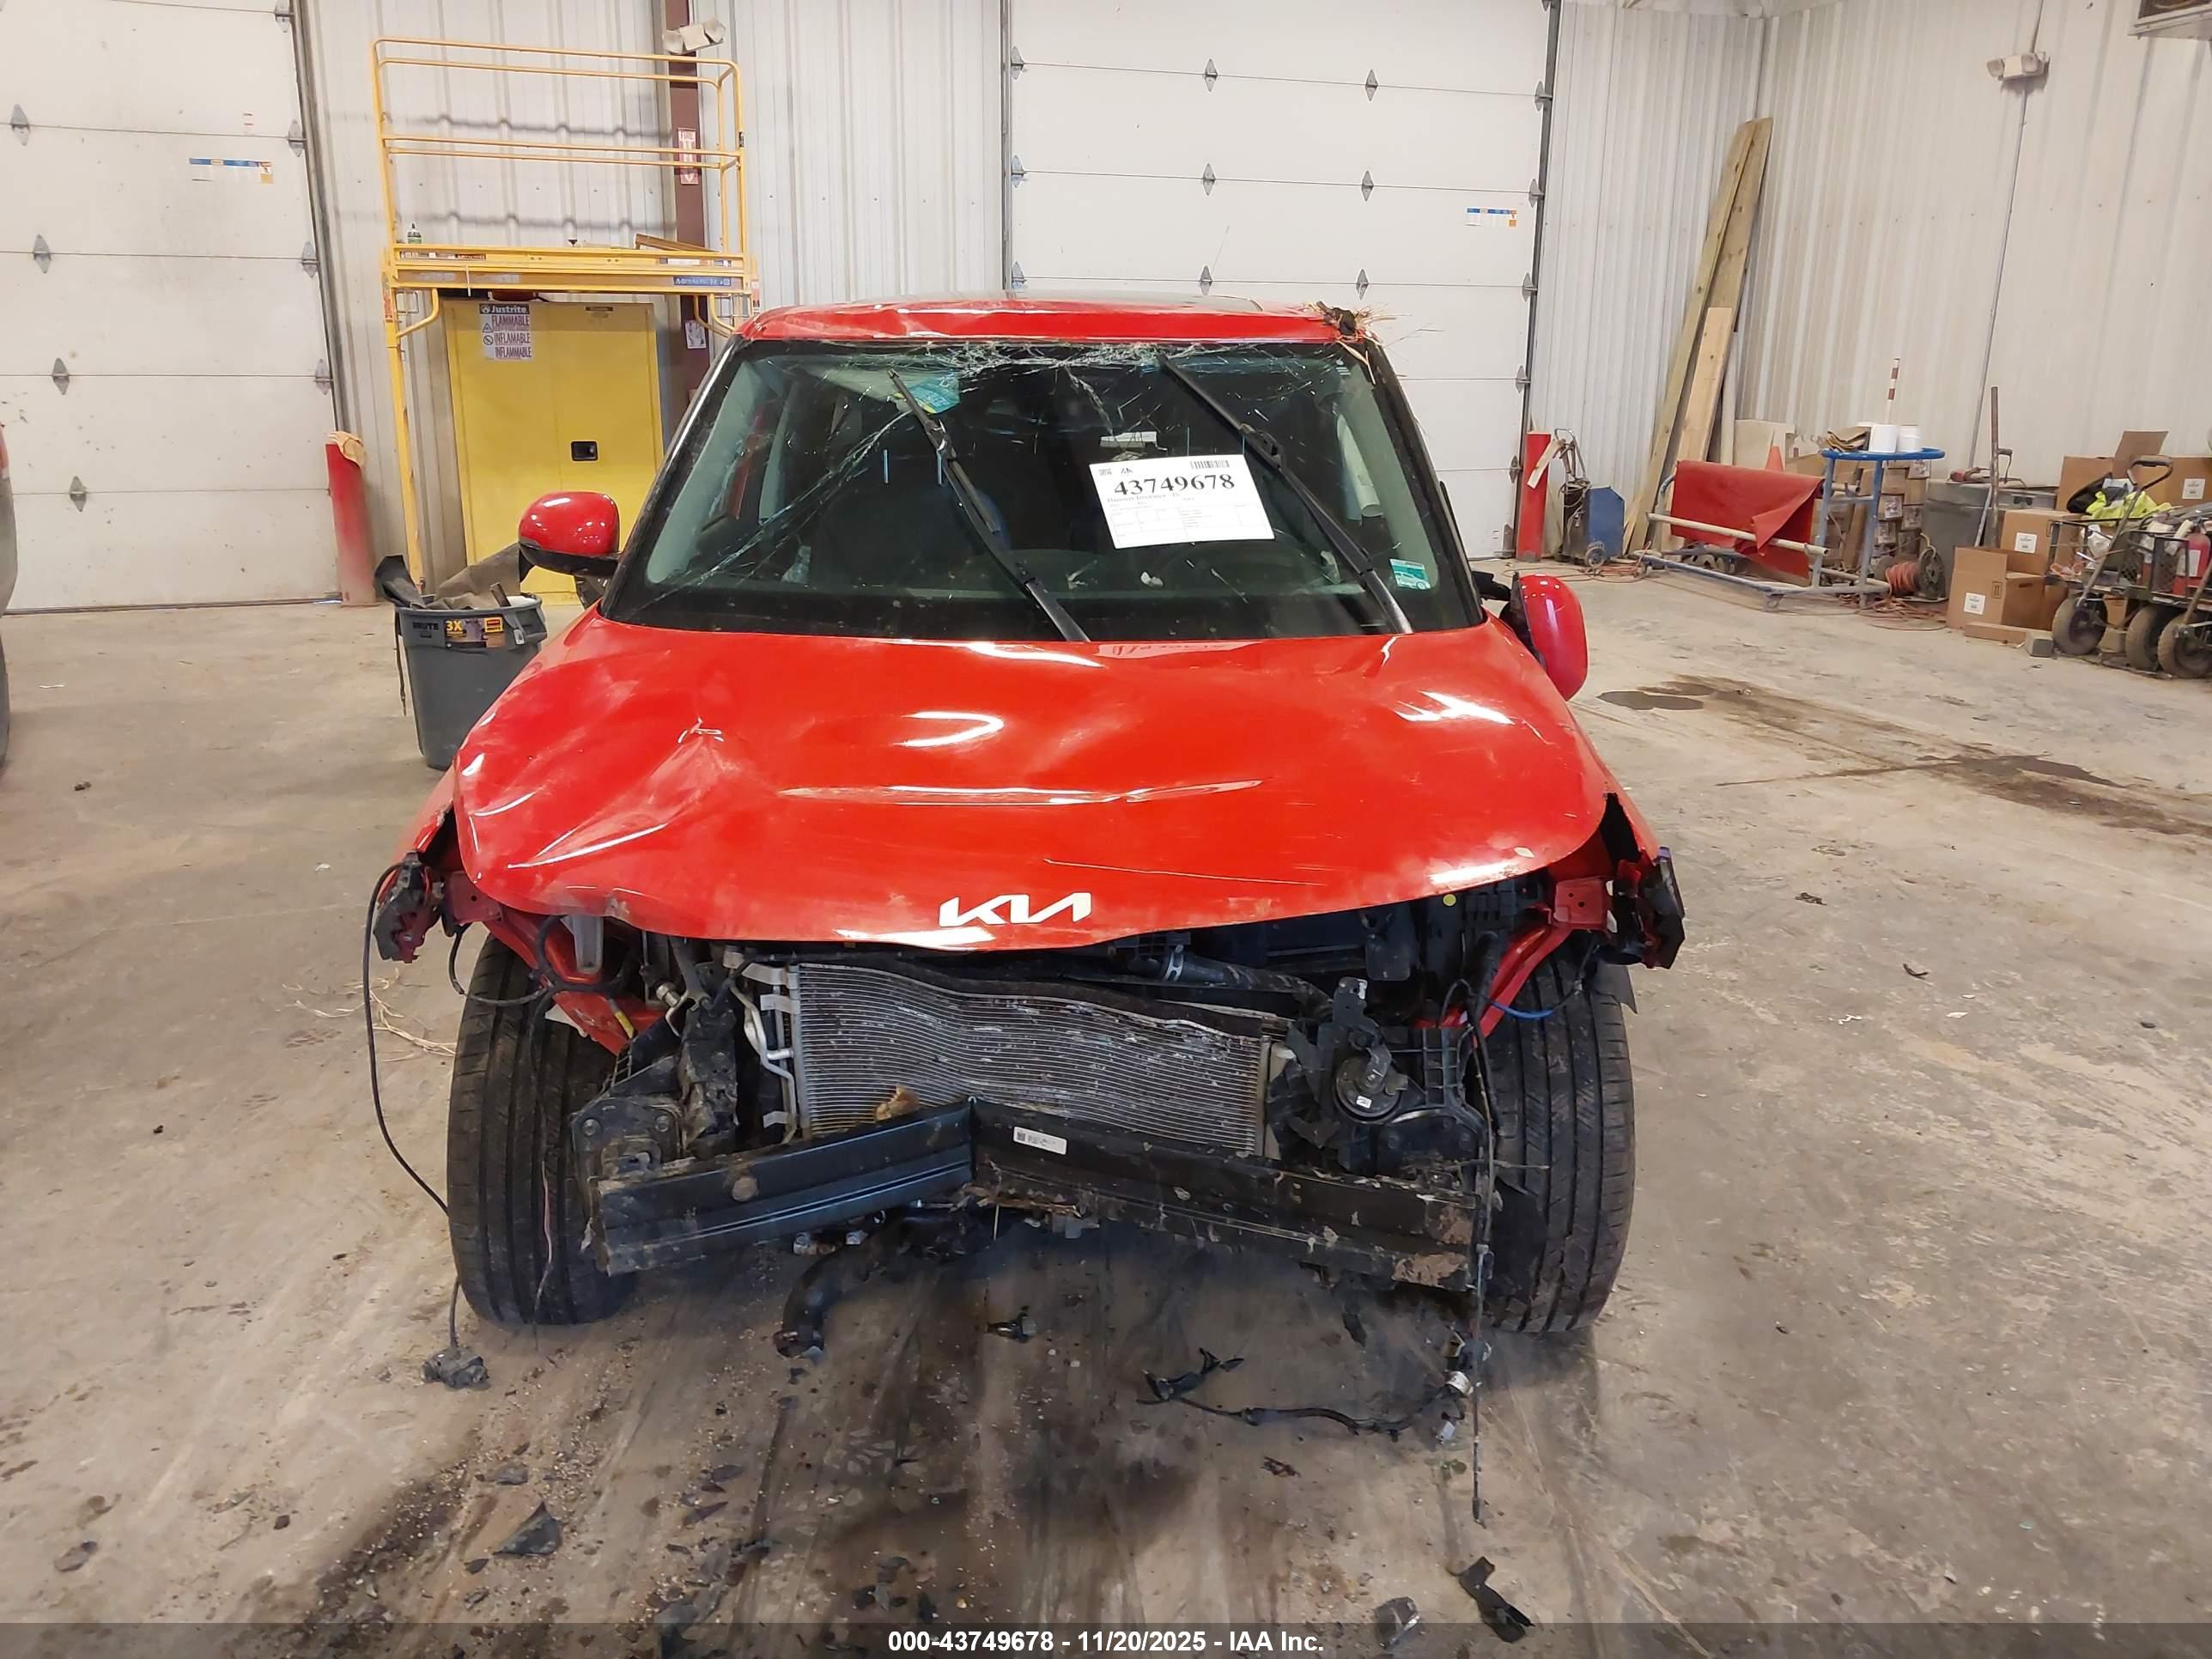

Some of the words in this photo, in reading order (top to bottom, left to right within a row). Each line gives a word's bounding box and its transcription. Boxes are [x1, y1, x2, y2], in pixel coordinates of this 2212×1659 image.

[491, 305, 526, 313] Justrite
[492, 315, 530, 326] FLAMMABLE
[494, 332, 531, 344] INFLAMABLE
[495, 346, 532, 358] INFLAMMABLE
[1114, 473, 1235, 495] 43749678
[446, 620, 462, 631] 3X
